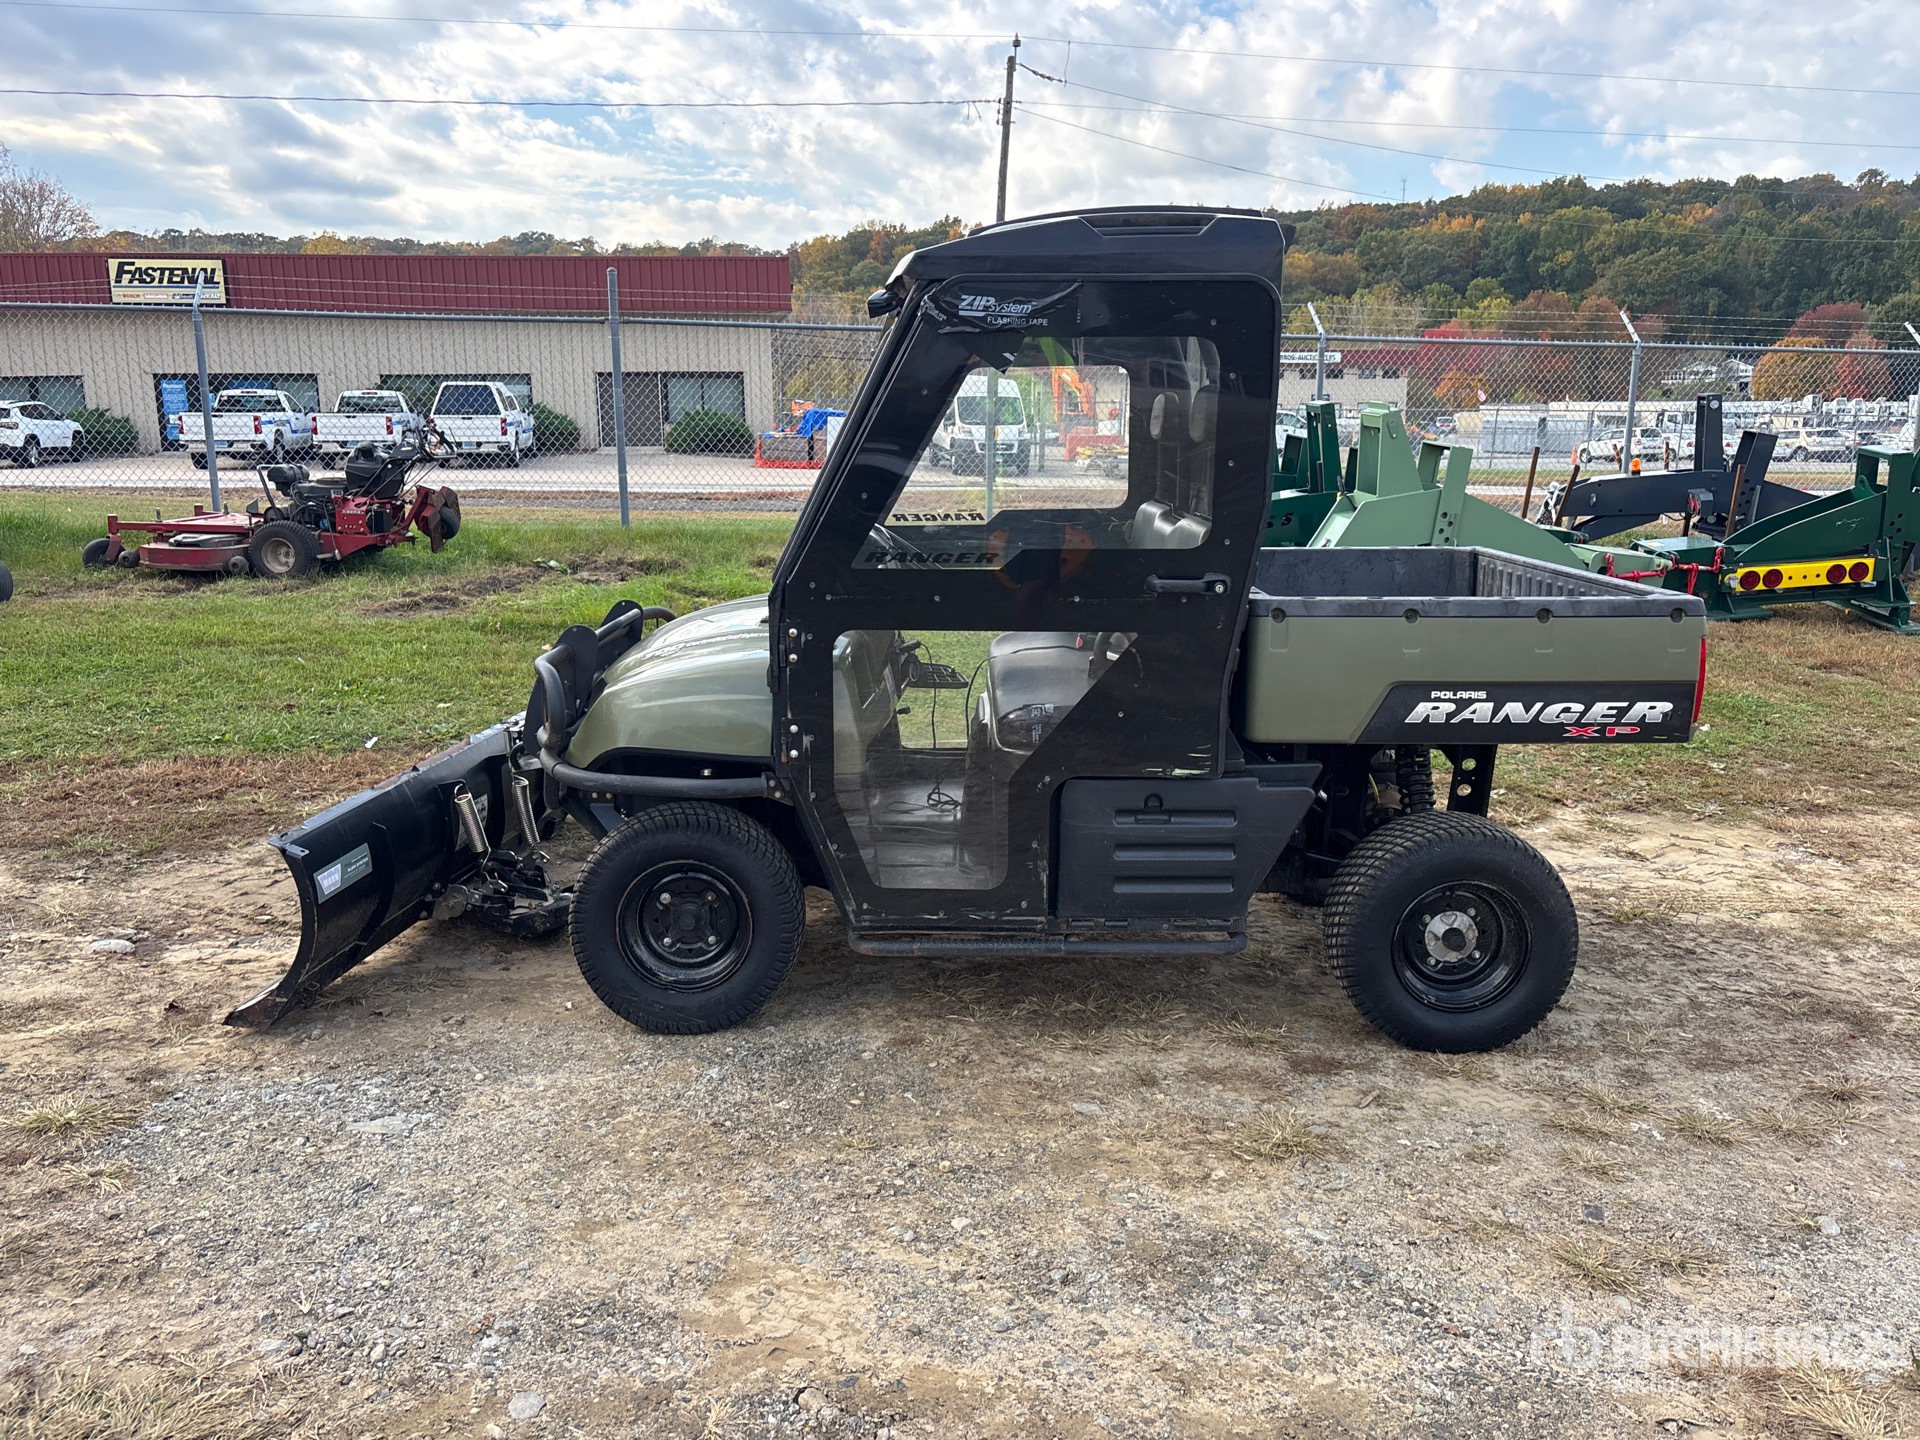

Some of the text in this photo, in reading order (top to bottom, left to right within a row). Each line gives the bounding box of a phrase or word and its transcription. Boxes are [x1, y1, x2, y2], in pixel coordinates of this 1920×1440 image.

[114, 261, 220, 285] FASTENAL
[987, 316, 1048, 326] FLASHING TAPE
[864, 551, 1000, 564] RANGER
[1431, 691, 1487, 699] POLARIS
[1404, 701, 1674, 724] RANGER
[1562, 726, 1640, 737] XP
